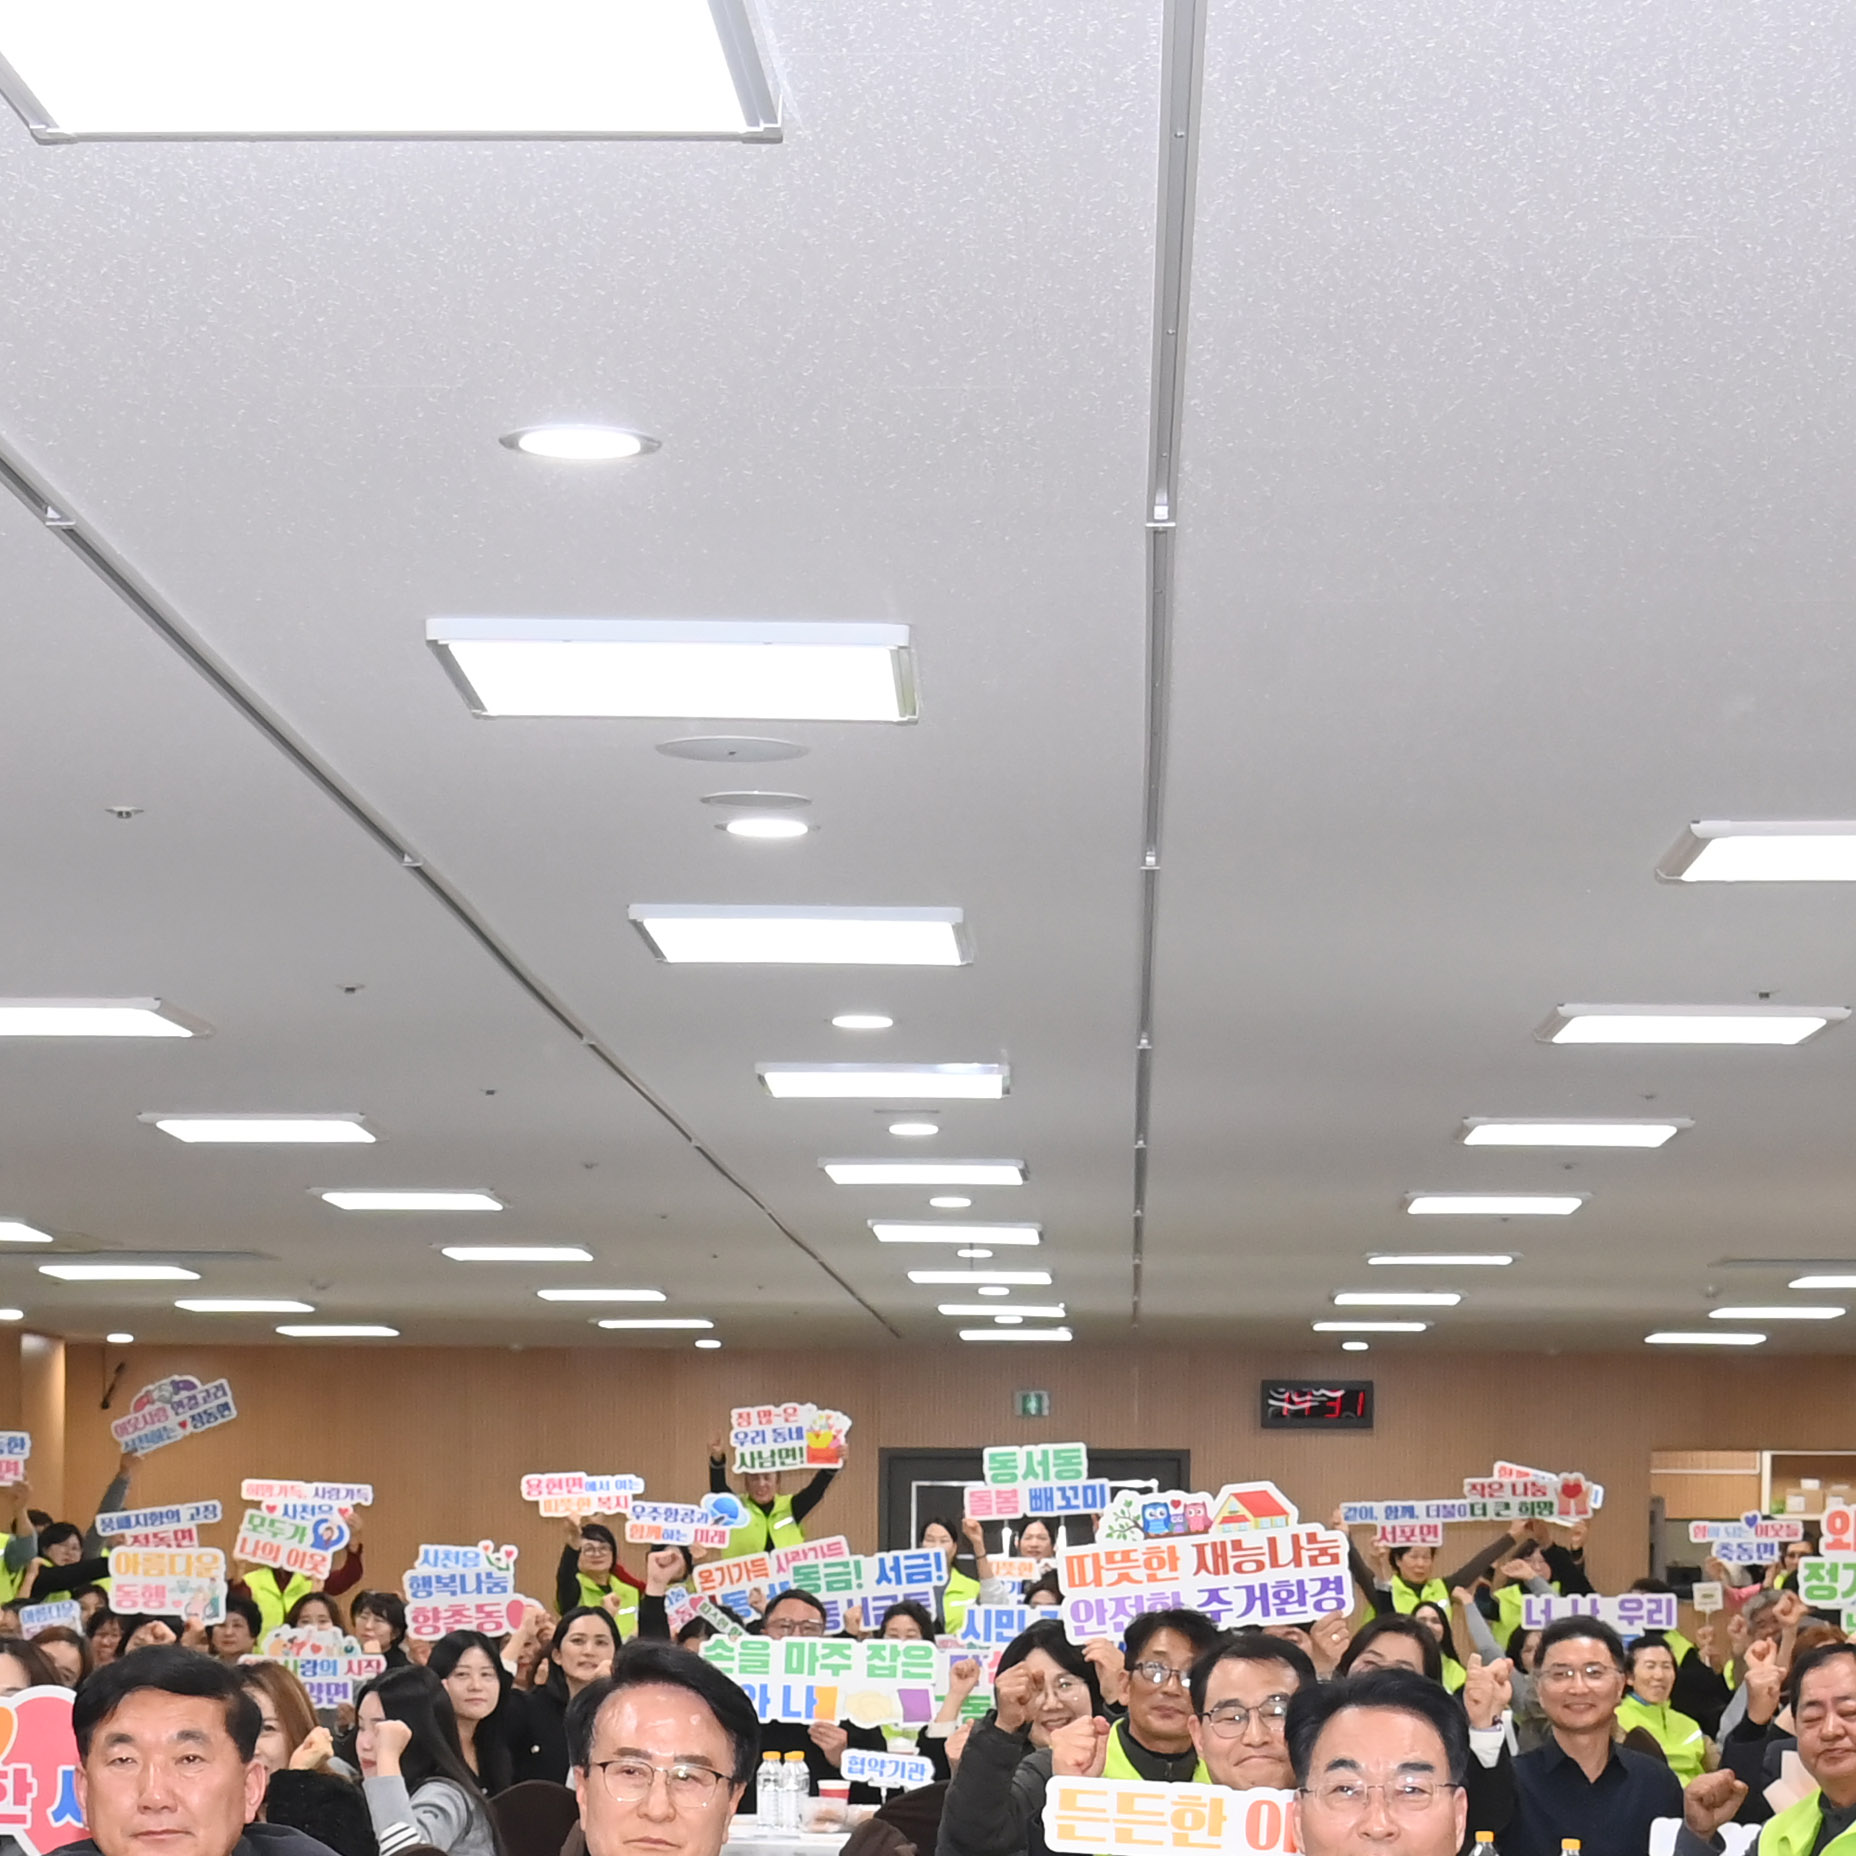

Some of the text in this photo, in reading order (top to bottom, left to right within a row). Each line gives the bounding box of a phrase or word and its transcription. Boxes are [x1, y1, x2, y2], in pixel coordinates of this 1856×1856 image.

[733, 1426, 804, 1447] 우리 동네
[737, 1446, 804, 1470] 사남면!
[988, 1448, 1083, 1484] 동서동
[969, 1488, 1019, 1516] 돌봄
[1468, 1481, 1547, 1498] 작은 나눔
[245, 1513, 307, 1544] 모두가
[1378, 1522, 1439, 1545] 서포면
[115, 1551, 221, 1577] 아름다운
[239, 1537, 328, 1574] 나의 이웃
[1066, 1531, 1341, 1588] 따뜻한 재능나눔
[408, 1572, 509, 1599] 행복나눔
[698, 1558, 770, 1592] 온기가득
[792, 1551, 943, 1594] 동금! 서금!
[115, 1584, 167, 1609] 동행
[1197, 1576, 1346, 1624] 주거환경
[961, 1609, 1026, 1643] 시민
[1526, 1598, 1552, 1626] 너
[1618, 1598, 1673, 1626] 우리
[345, 1658, 382, 1677] 시작
[704, 1638, 771, 1675] 손을
[785, 1641, 852, 1677] 마주
[866, 1643, 934, 1680] 잡은
[847, 1755, 927, 1782] 협약기관
[1055, 1788, 1227, 1850] 든든한
